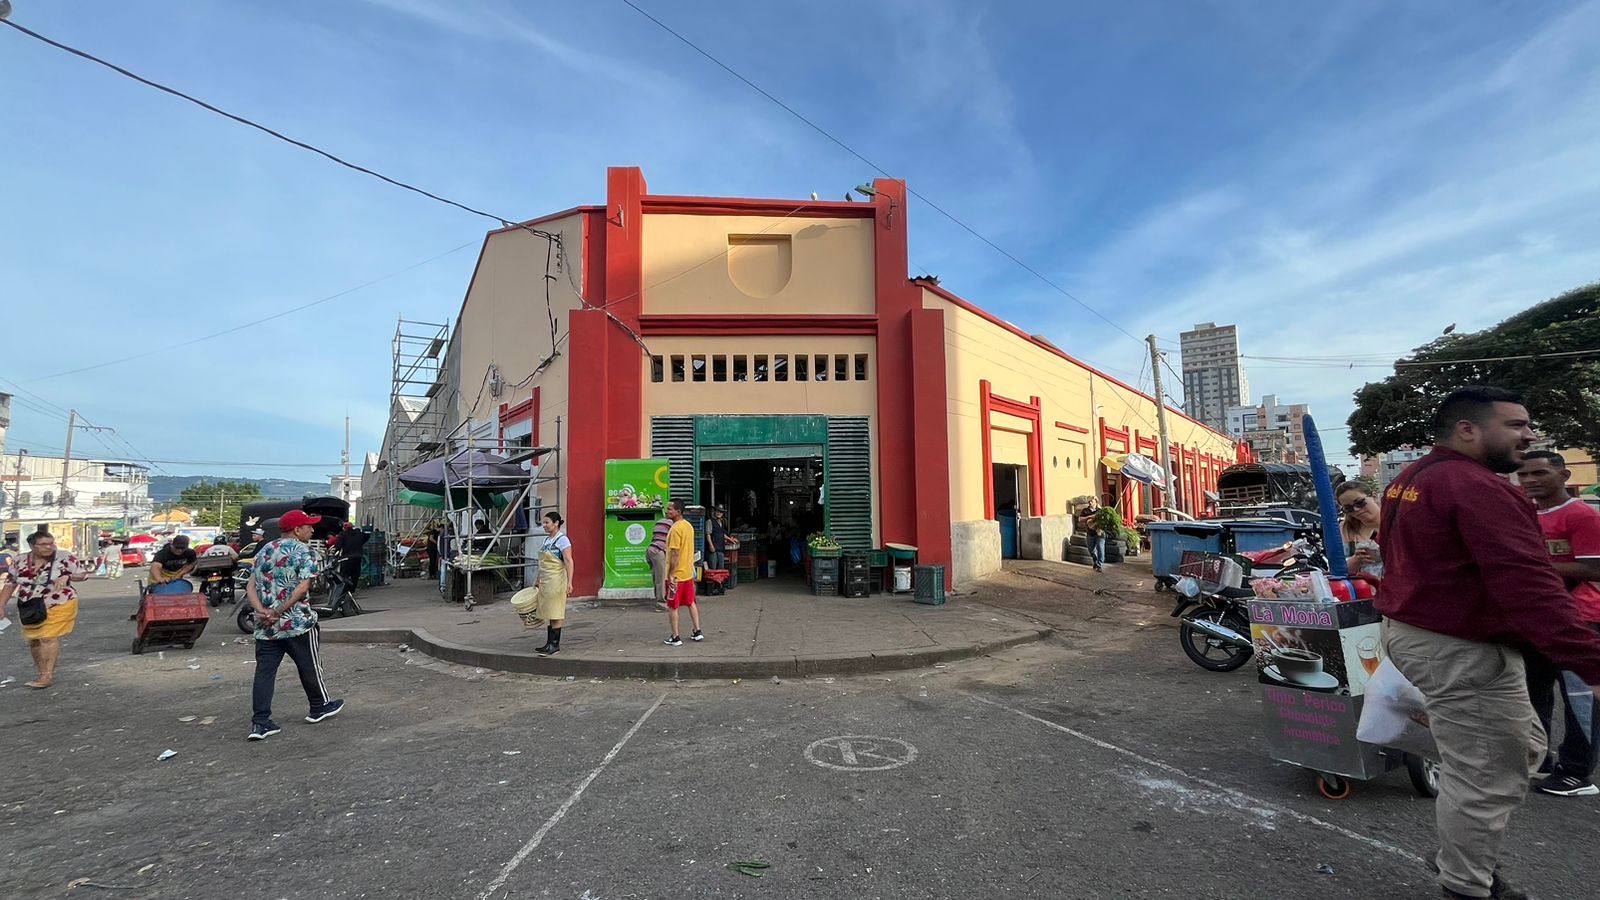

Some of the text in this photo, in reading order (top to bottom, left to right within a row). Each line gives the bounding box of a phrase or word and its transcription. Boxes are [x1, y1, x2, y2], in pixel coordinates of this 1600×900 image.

[1252, 605, 1332, 625] La Mona
[1304, 693, 1346, 713] Perico
[1279, 707, 1337, 727] Chocolate
